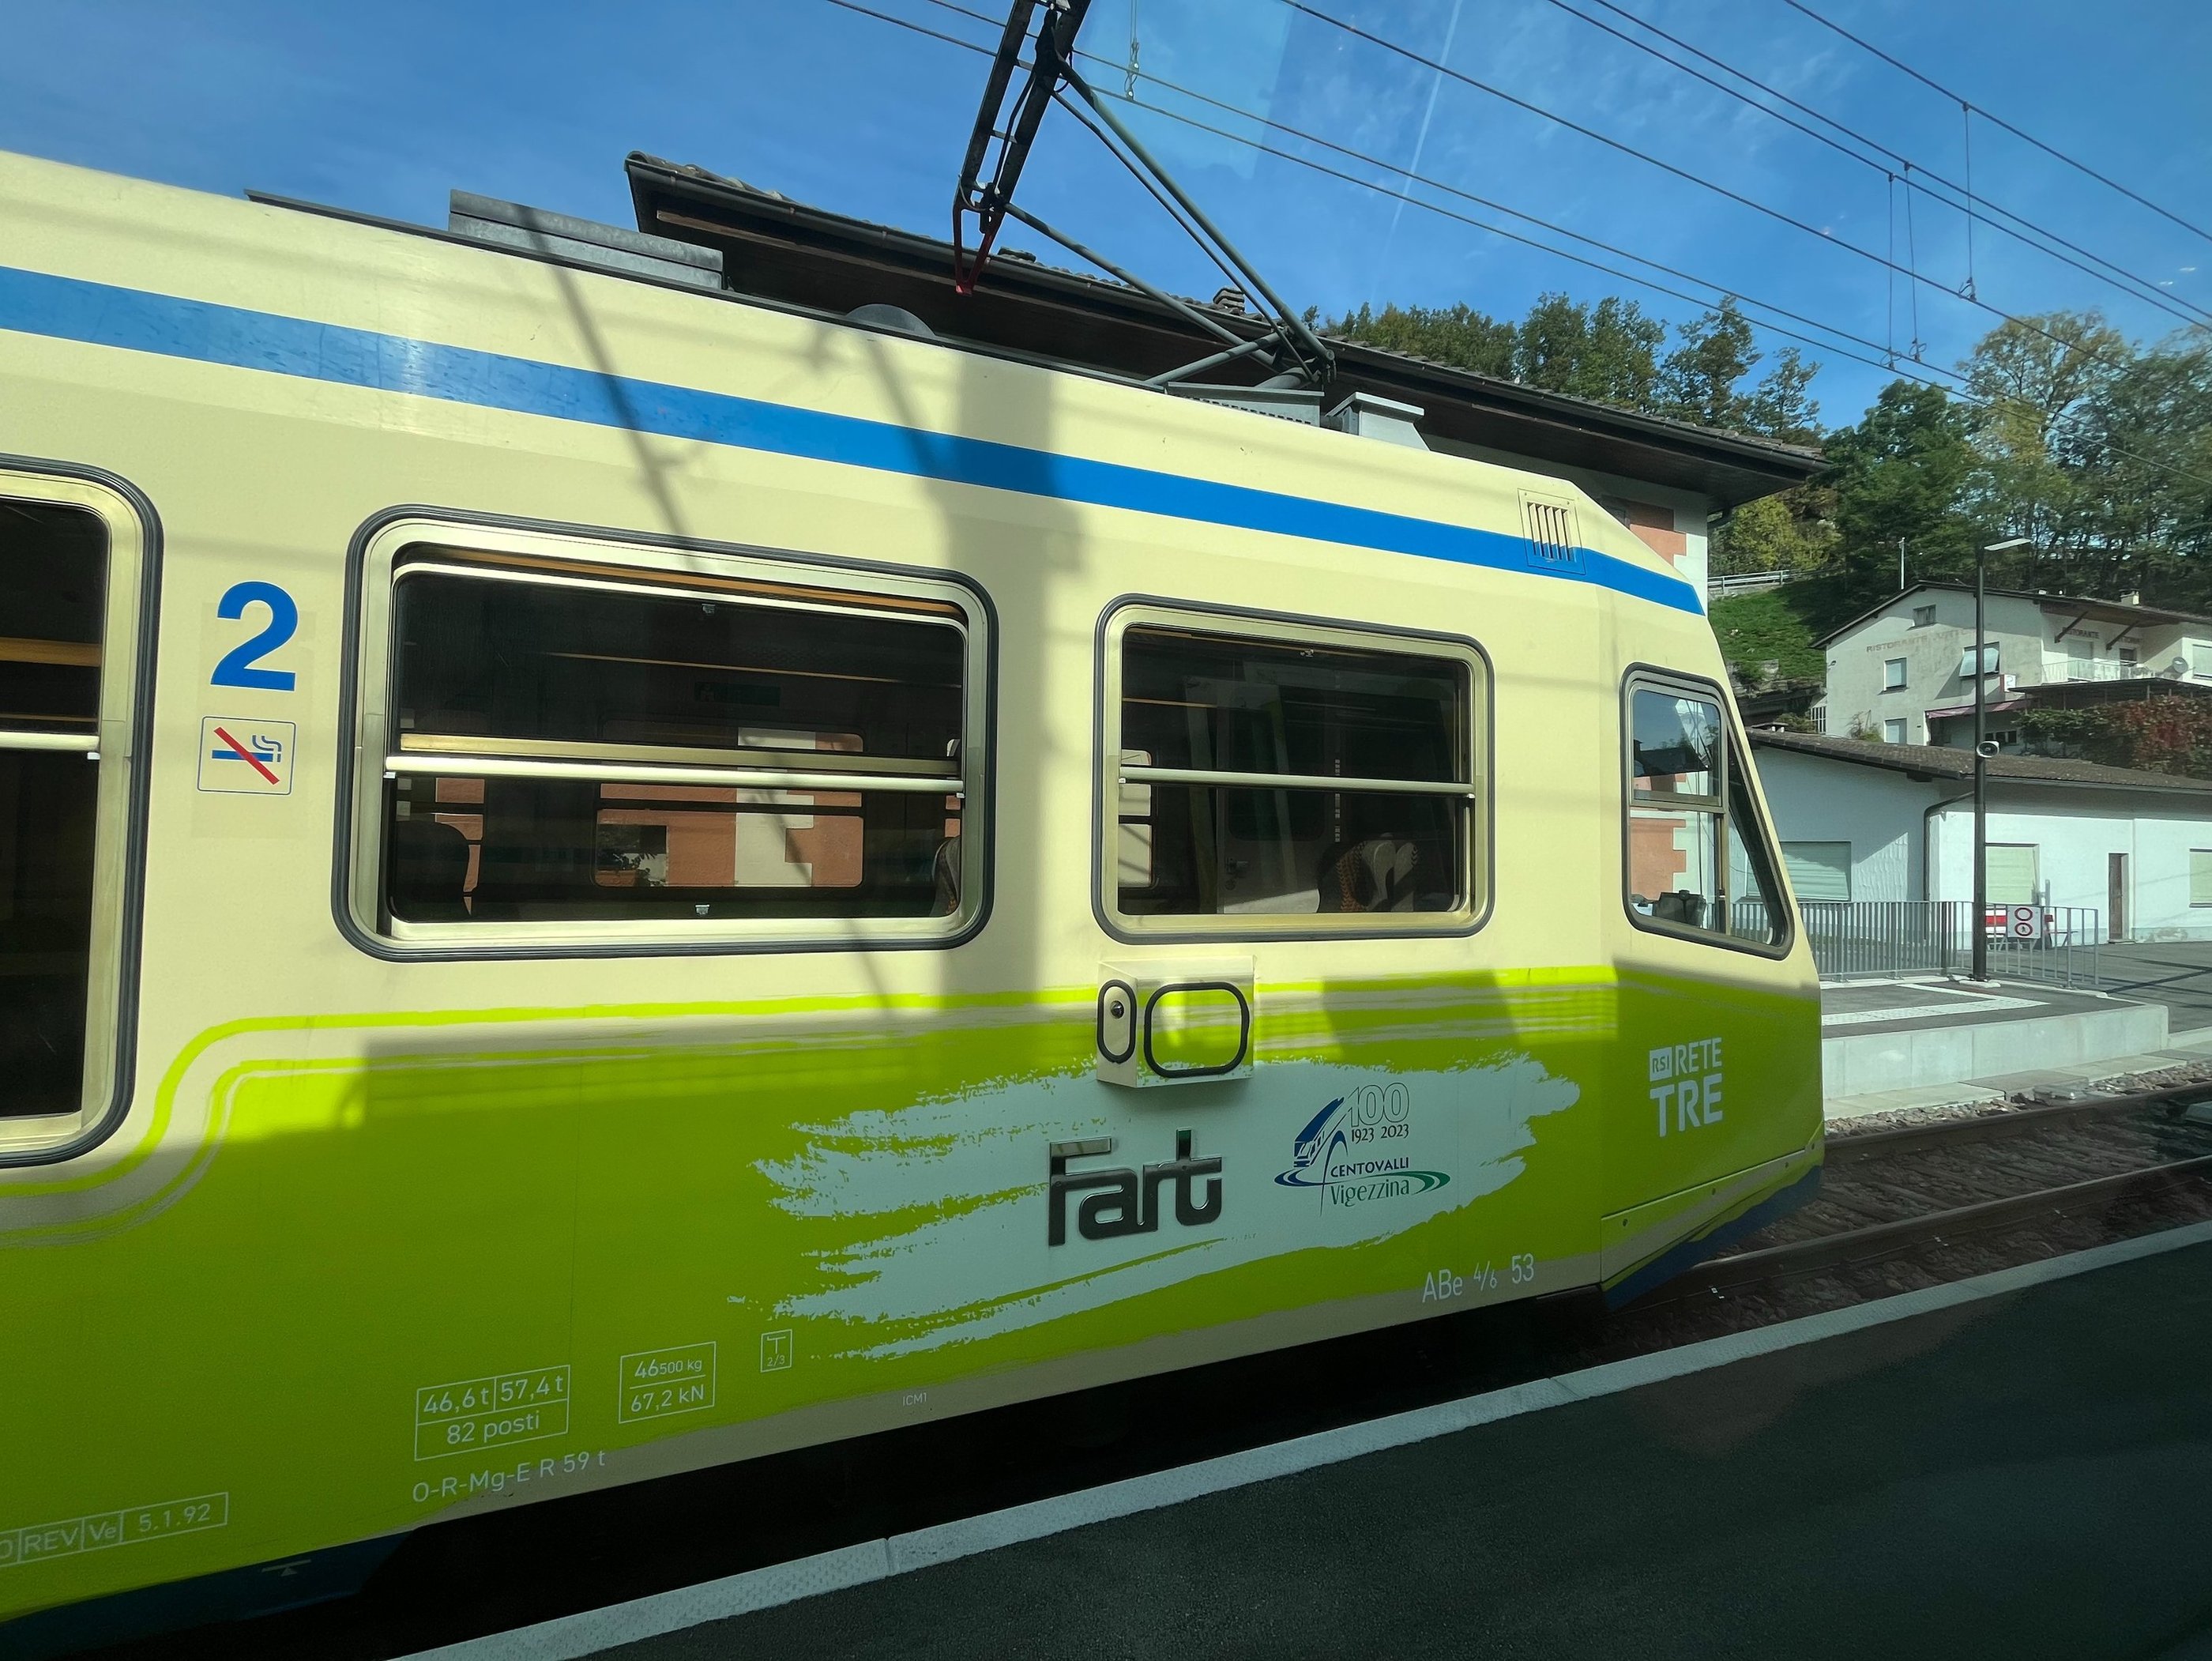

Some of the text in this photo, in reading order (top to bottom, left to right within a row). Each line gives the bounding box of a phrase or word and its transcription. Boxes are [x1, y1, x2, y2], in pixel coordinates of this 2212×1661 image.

[210, 581, 299, 691] 2
[1653, 1037, 1722, 1076] RSI RETE
[1348, 1083, 1409, 1128] 100
[1650, 1073, 1722, 1138] TRE
[1351, 1124, 1409, 1144] 1923 2023
[1330, 1157, 1409, 1177] CENTOVALLI
[1048, 1127, 1222, 1246] Fart
[1330, 1179, 1409, 1207] Vigezzina
[1422, 1252, 1534, 1303] ABe 4/6 53
[634, 1358, 702, 1378] 46500 kg
[767, 1354, 785, 1368] 2/3
[423, 1388, 489, 1414] 46,6 t
[500, 1375, 563, 1402] 57,4 t
[631, 1384, 704, 1412] 67,2 kN
[447, 1411, 540, 1444] 82 posti
[412, 1450, 605, 1502] O-R-Mg-E R 59 t
[89, 1521, 116, 1541] Ve
[139, 1503, 210, 1532] 5.1.92
[24, 1527, 77, 1554] REV
